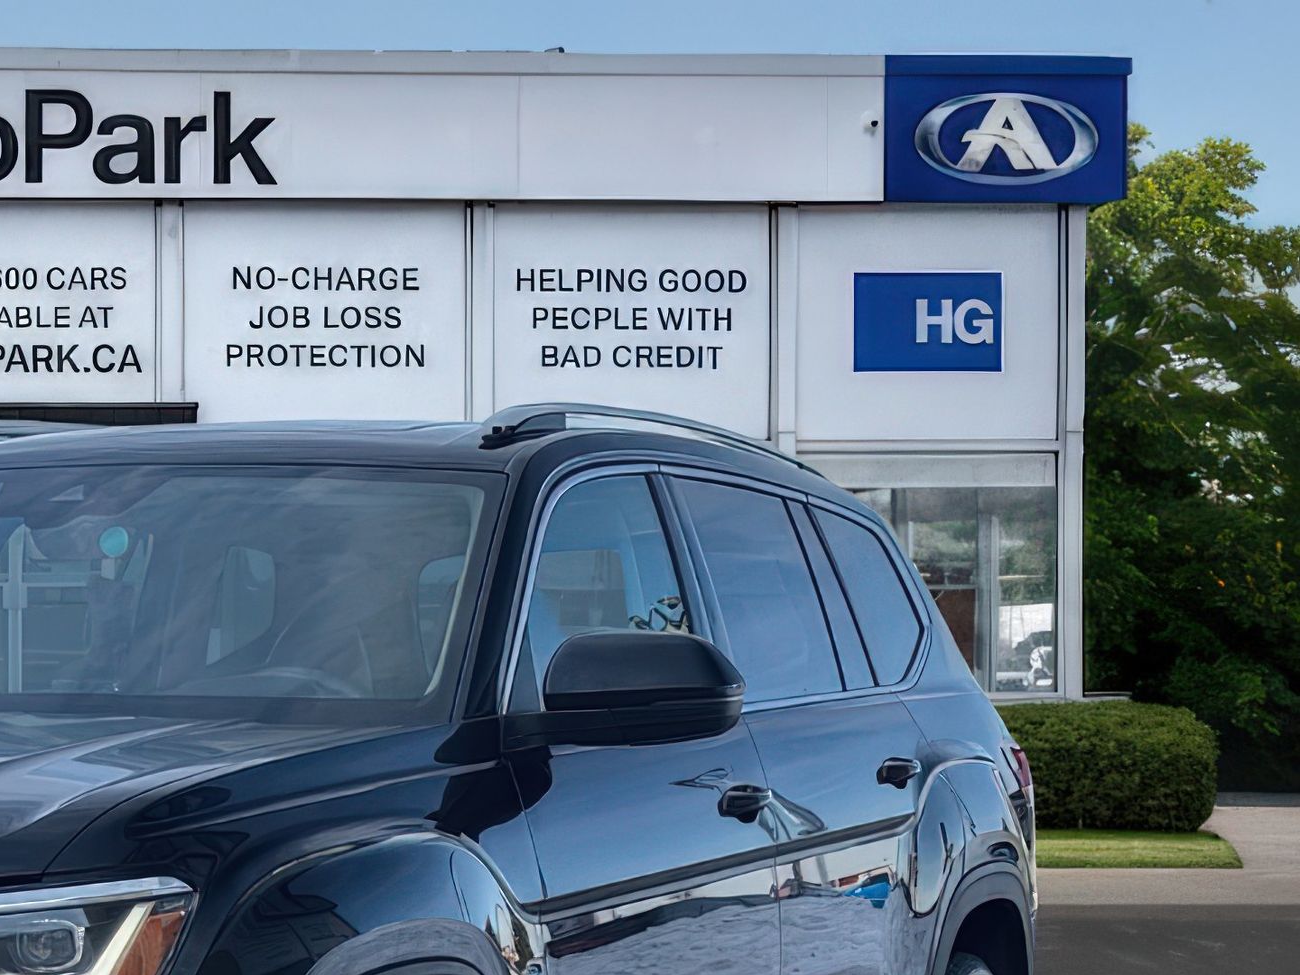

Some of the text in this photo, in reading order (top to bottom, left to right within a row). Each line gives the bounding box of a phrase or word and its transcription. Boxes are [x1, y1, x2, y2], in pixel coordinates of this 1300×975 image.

[46, 266, 127, 291] CARS
[232, 265, 420, 292] NO-CHARGE
[516, 268, 747, 294] HELPING GOOD
[78, 305, 114, 329] AT
[248, 305, 402, 330] JOB LOSS
[656, 307, 732, 332] WITH
[915, 298, 994, 344] HG
[226, 343, 425, 368] PROTECTION
[541, 345, 724, 370] BAD CREDIT
